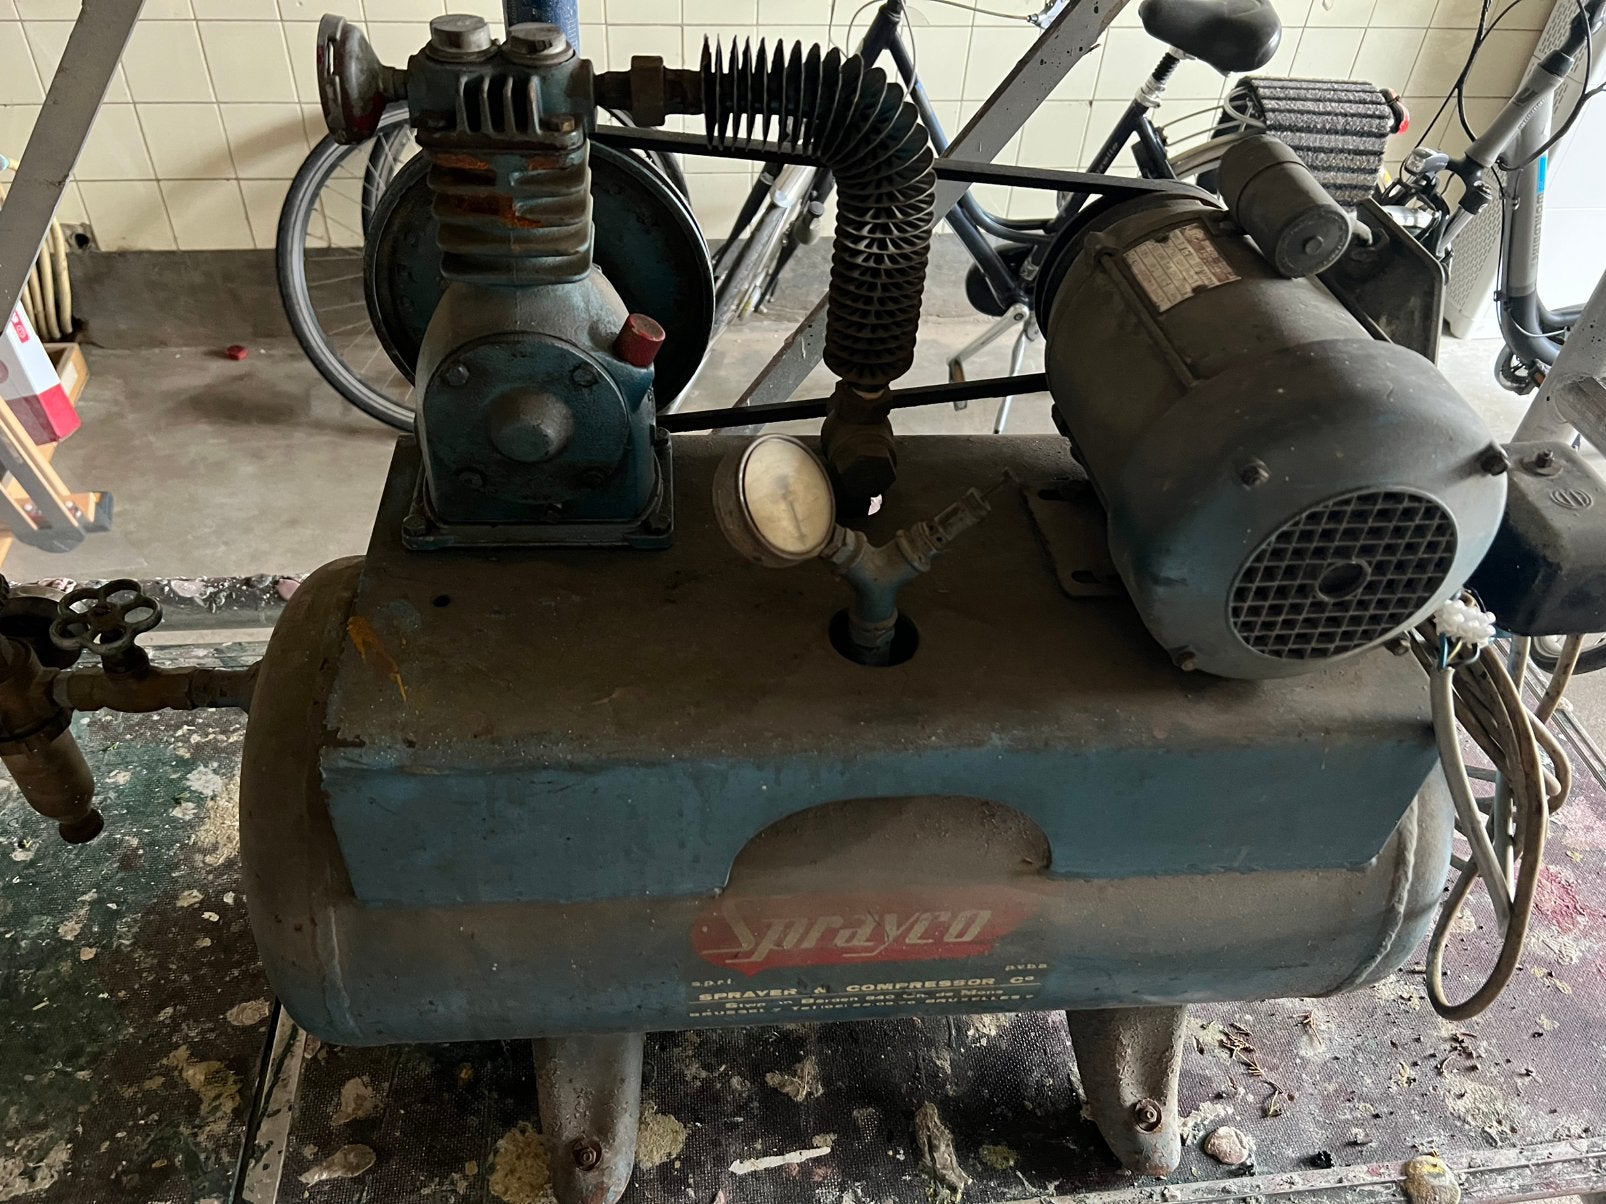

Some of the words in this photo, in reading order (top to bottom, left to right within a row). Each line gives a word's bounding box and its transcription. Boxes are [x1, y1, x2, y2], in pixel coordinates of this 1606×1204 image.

[702, 899, 992, 962] Sprayco
[699, 988, 798, 1001] SPRAYER
[846, 977, 996, 992] COMPRESSOR
